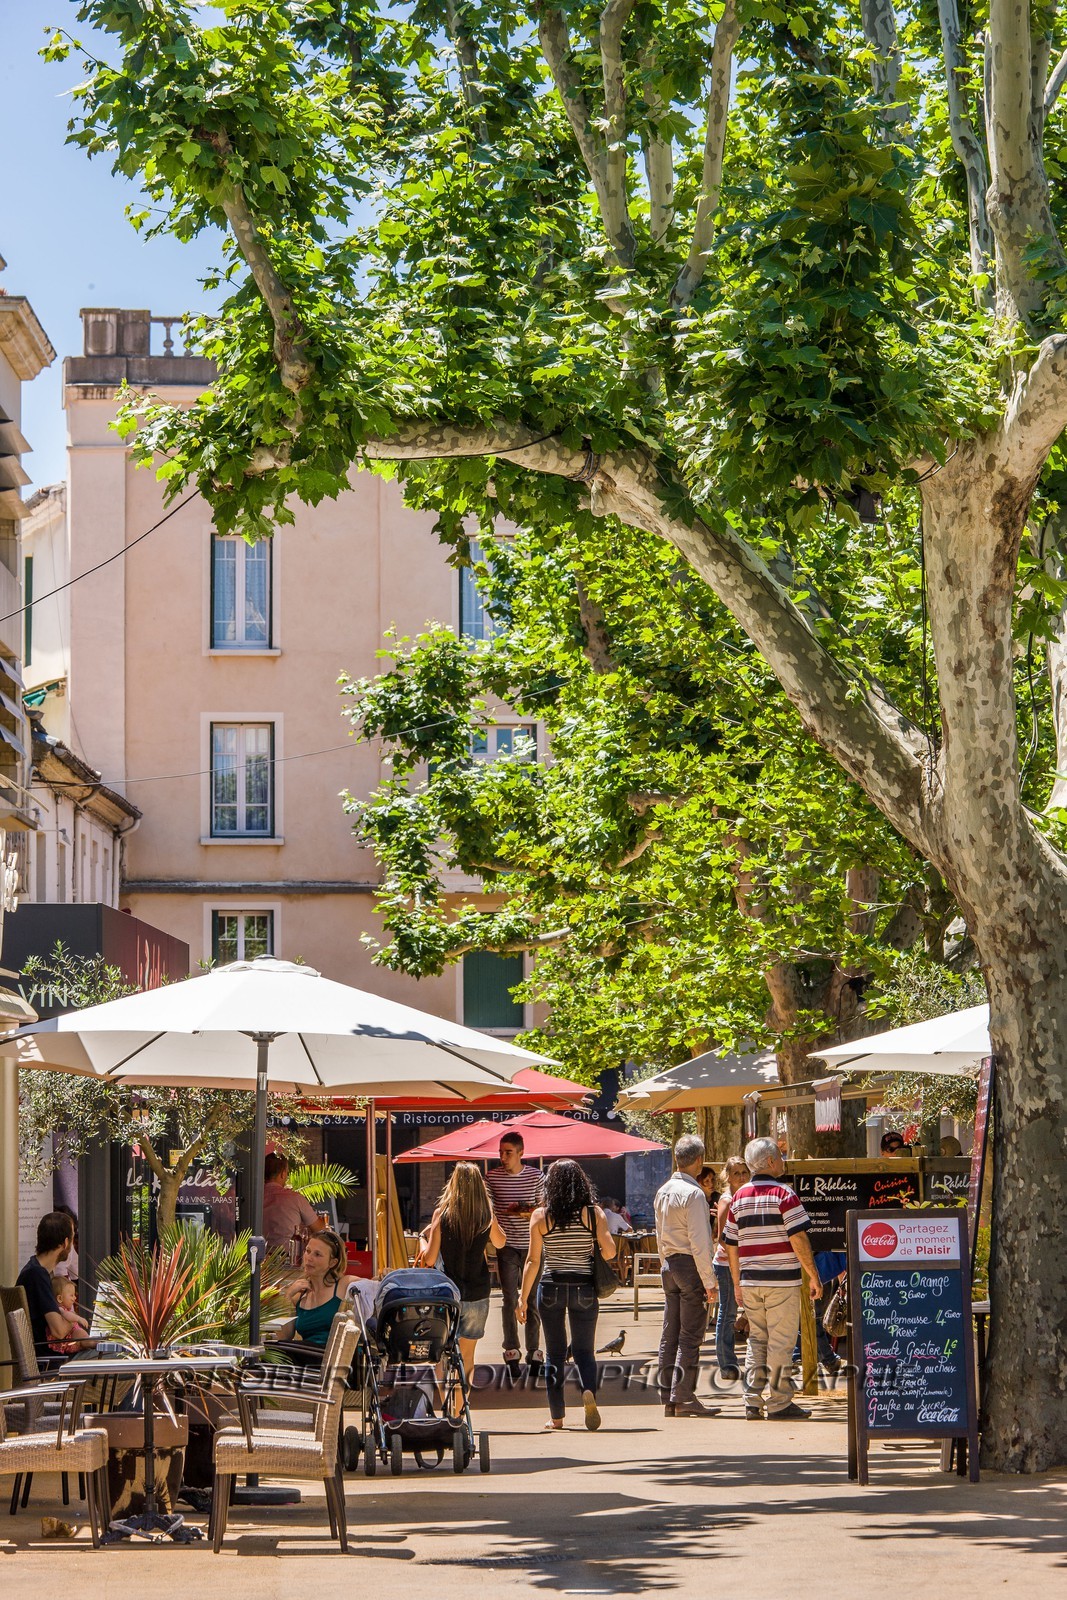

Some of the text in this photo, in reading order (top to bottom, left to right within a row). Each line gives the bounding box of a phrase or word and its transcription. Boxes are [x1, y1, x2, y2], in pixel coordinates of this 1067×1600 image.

[403, 1113, 475, 1125] Ristorante
[126, 1167, 144, 1188] Le
[800, 1176, 858, 1196] Le Rabelais
[873, 1176, 909, 1192] Cuisine
[190, 1196, 206, 1204] VINS
[211, 1196, 233, 1205] TAPAS
[898, 1224, 949, 1235] Partagez
[863, 1234, 897, 1247] Coca-Cola
[900, 1235, 956, 1245] un moment
[900, 1245, 951, 1255] de Plaisir
[894, 1279, 908, 1289] ou
[862, 1309, 933, 1330] Pamplemousse
[904, 1402, 915, 1412] au
[916, 1407, 960, 1423] Coca-Cola
